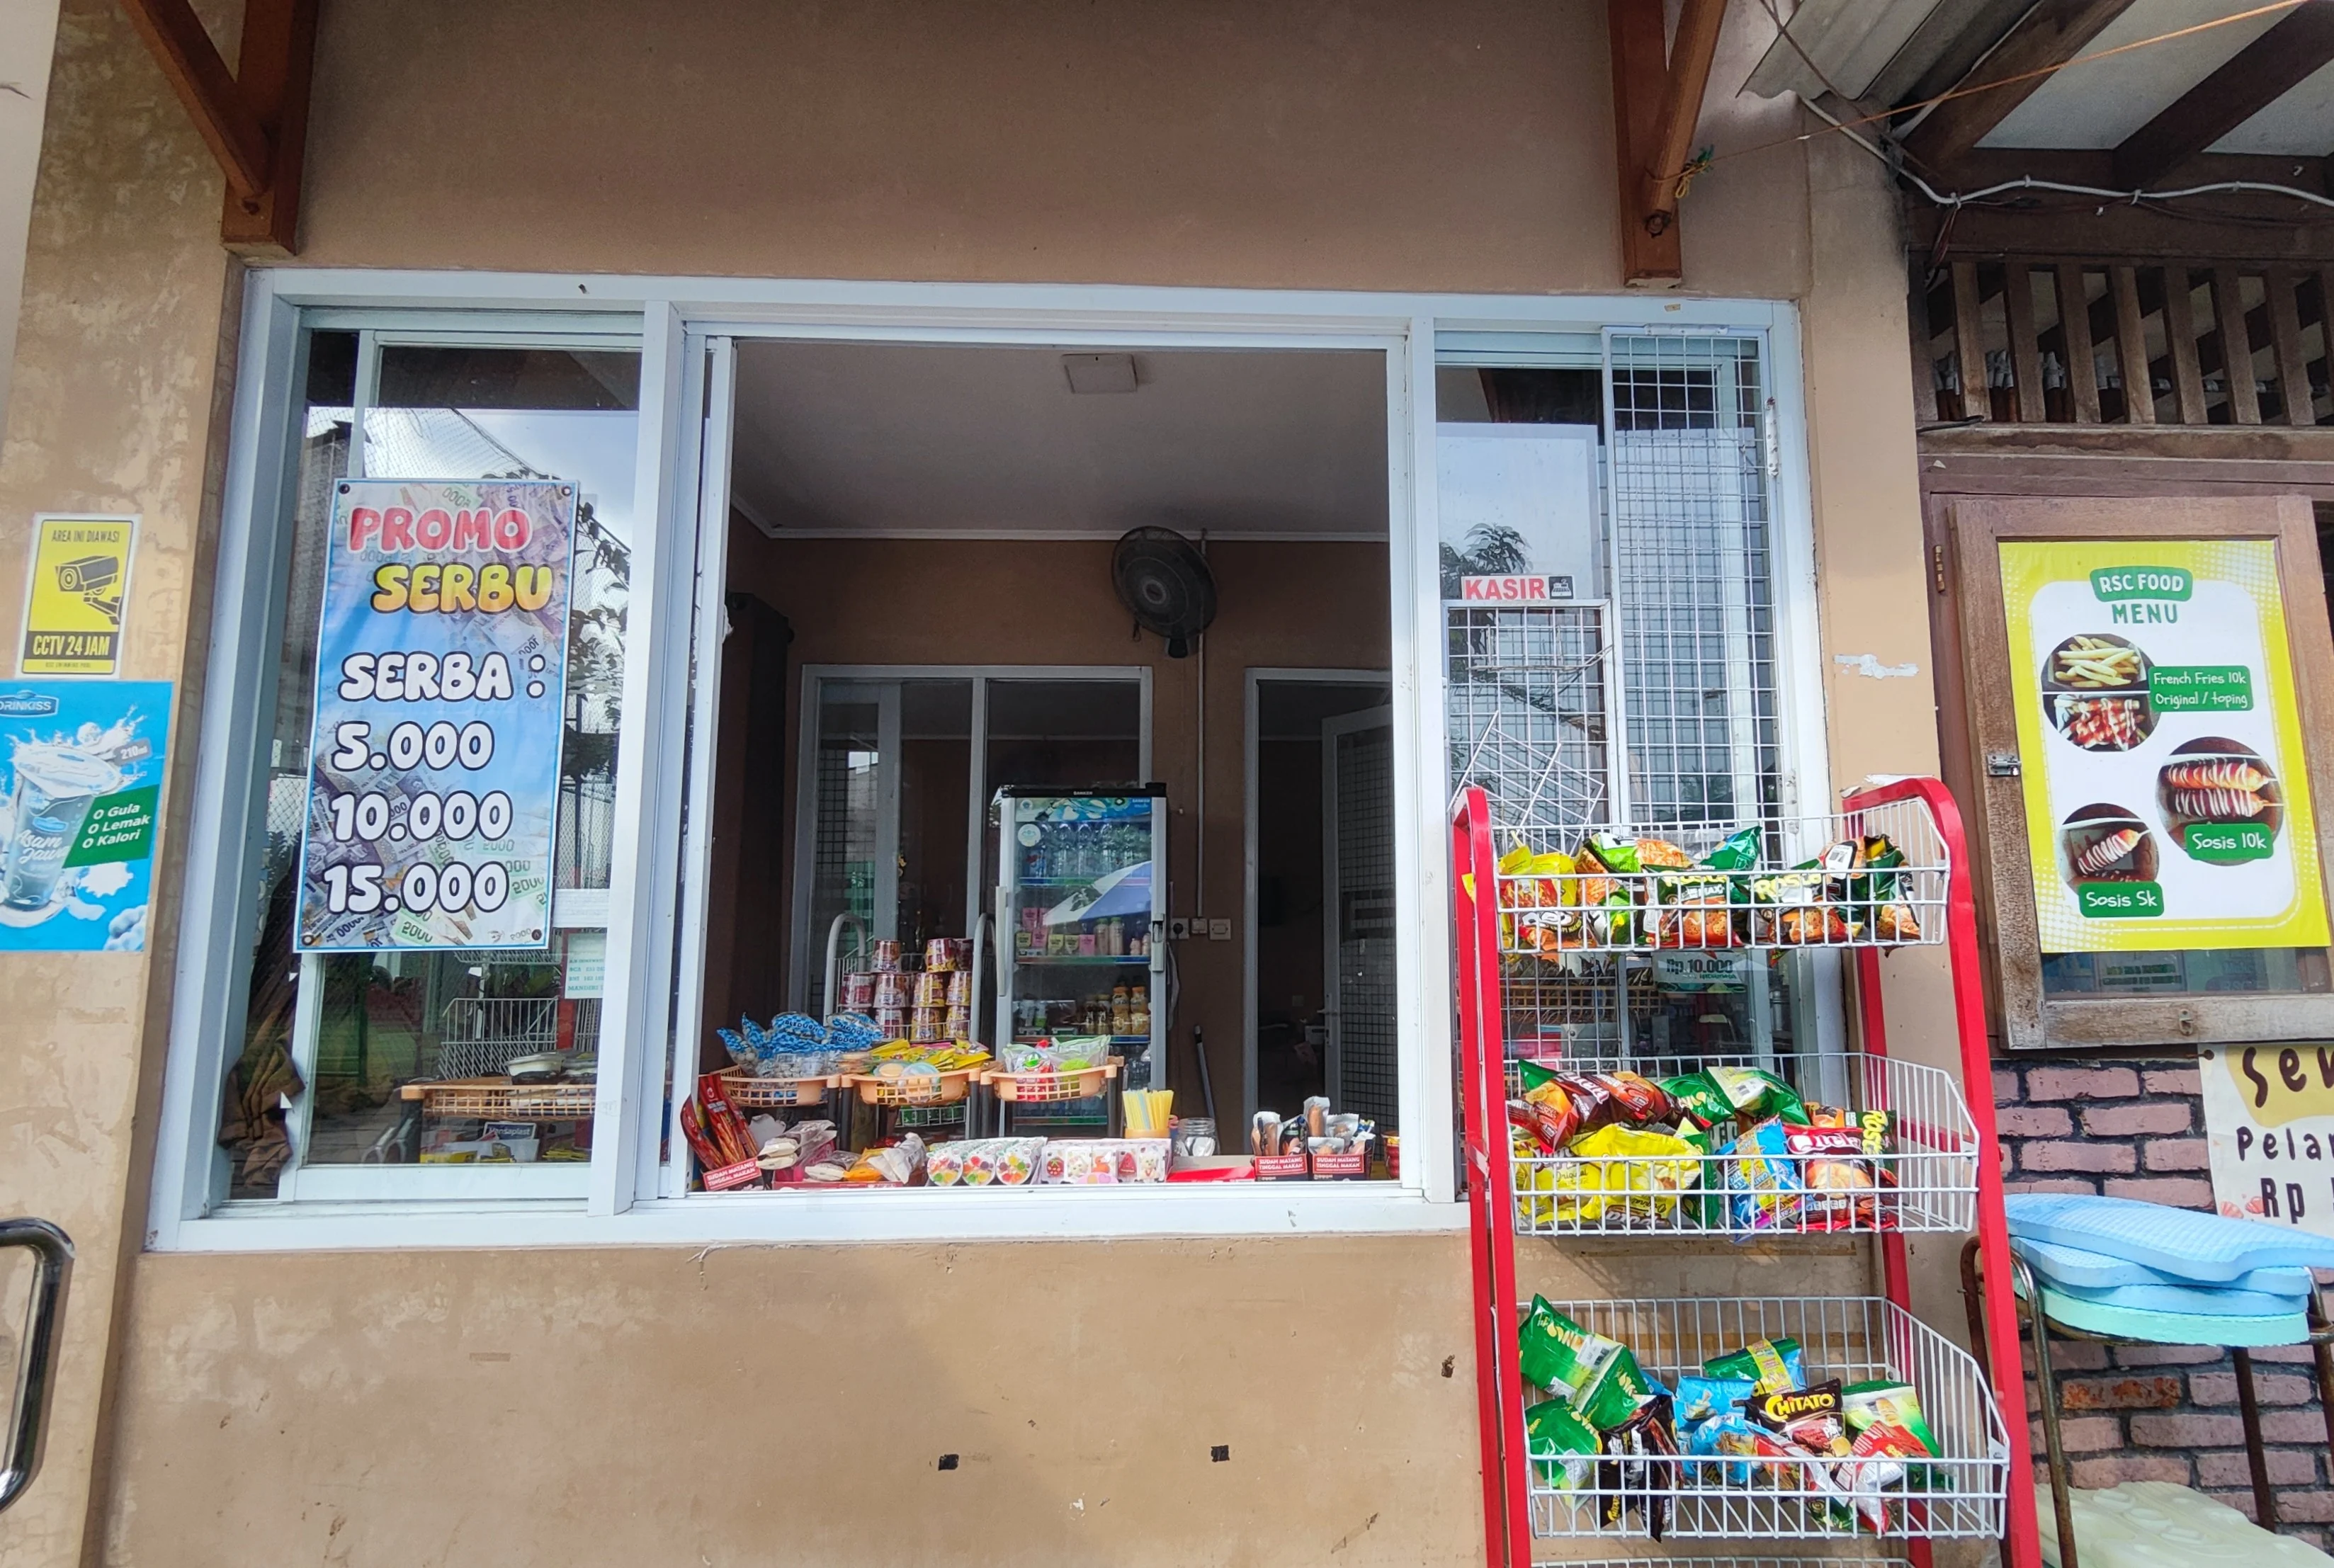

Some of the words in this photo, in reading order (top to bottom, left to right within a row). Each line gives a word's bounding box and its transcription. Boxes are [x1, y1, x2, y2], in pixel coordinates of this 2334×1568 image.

[51, 530, 72, 542] AREA
[73, 530, 84, 542] INI
[86, 530, 120, 542] DIAWASI
[348, 506, 532, 552] PROMO
[370, 562, 553, 614] SERBU
[1465, 578, 1546, 601] KASIR
[2099, 574, 2134, 593] RSC
[2137, 574, 2184, 592] FOOD
[2112, 603, 2178, 624] MENU
[33, 635, 65, 656] CCTV
[66, 635, 83, 656] 24
[84, 635, 111, 656] JAM
[338, 652, 514, 701] SERBA
[2153, 671, 2192, 685] French
[2194, 671, 2225, 685] Fries
[2228, 671, 2247, 684] 10k
[2155, 691, 2199, 710] Original
[2211, 691, 2248, 709] toping
[331, 721, 495, 772] 5.000
[108, 803, 140, 818] Gula
[329, 790, 514, 842] 10.000
[102, 814, 151, 832] Lemak
[96, 829, 141, 847] Kalori
[2192, 833, 2236, 850] Sosis
[2240, 831, 2267, 850] 10k
[324, 861, 509, 914] 15.000
[2085, 891, 2132, 909] Sosis
[2136, 890, 2158, 907] 5k
[2260, 1178, 2305, 1224] Rp
